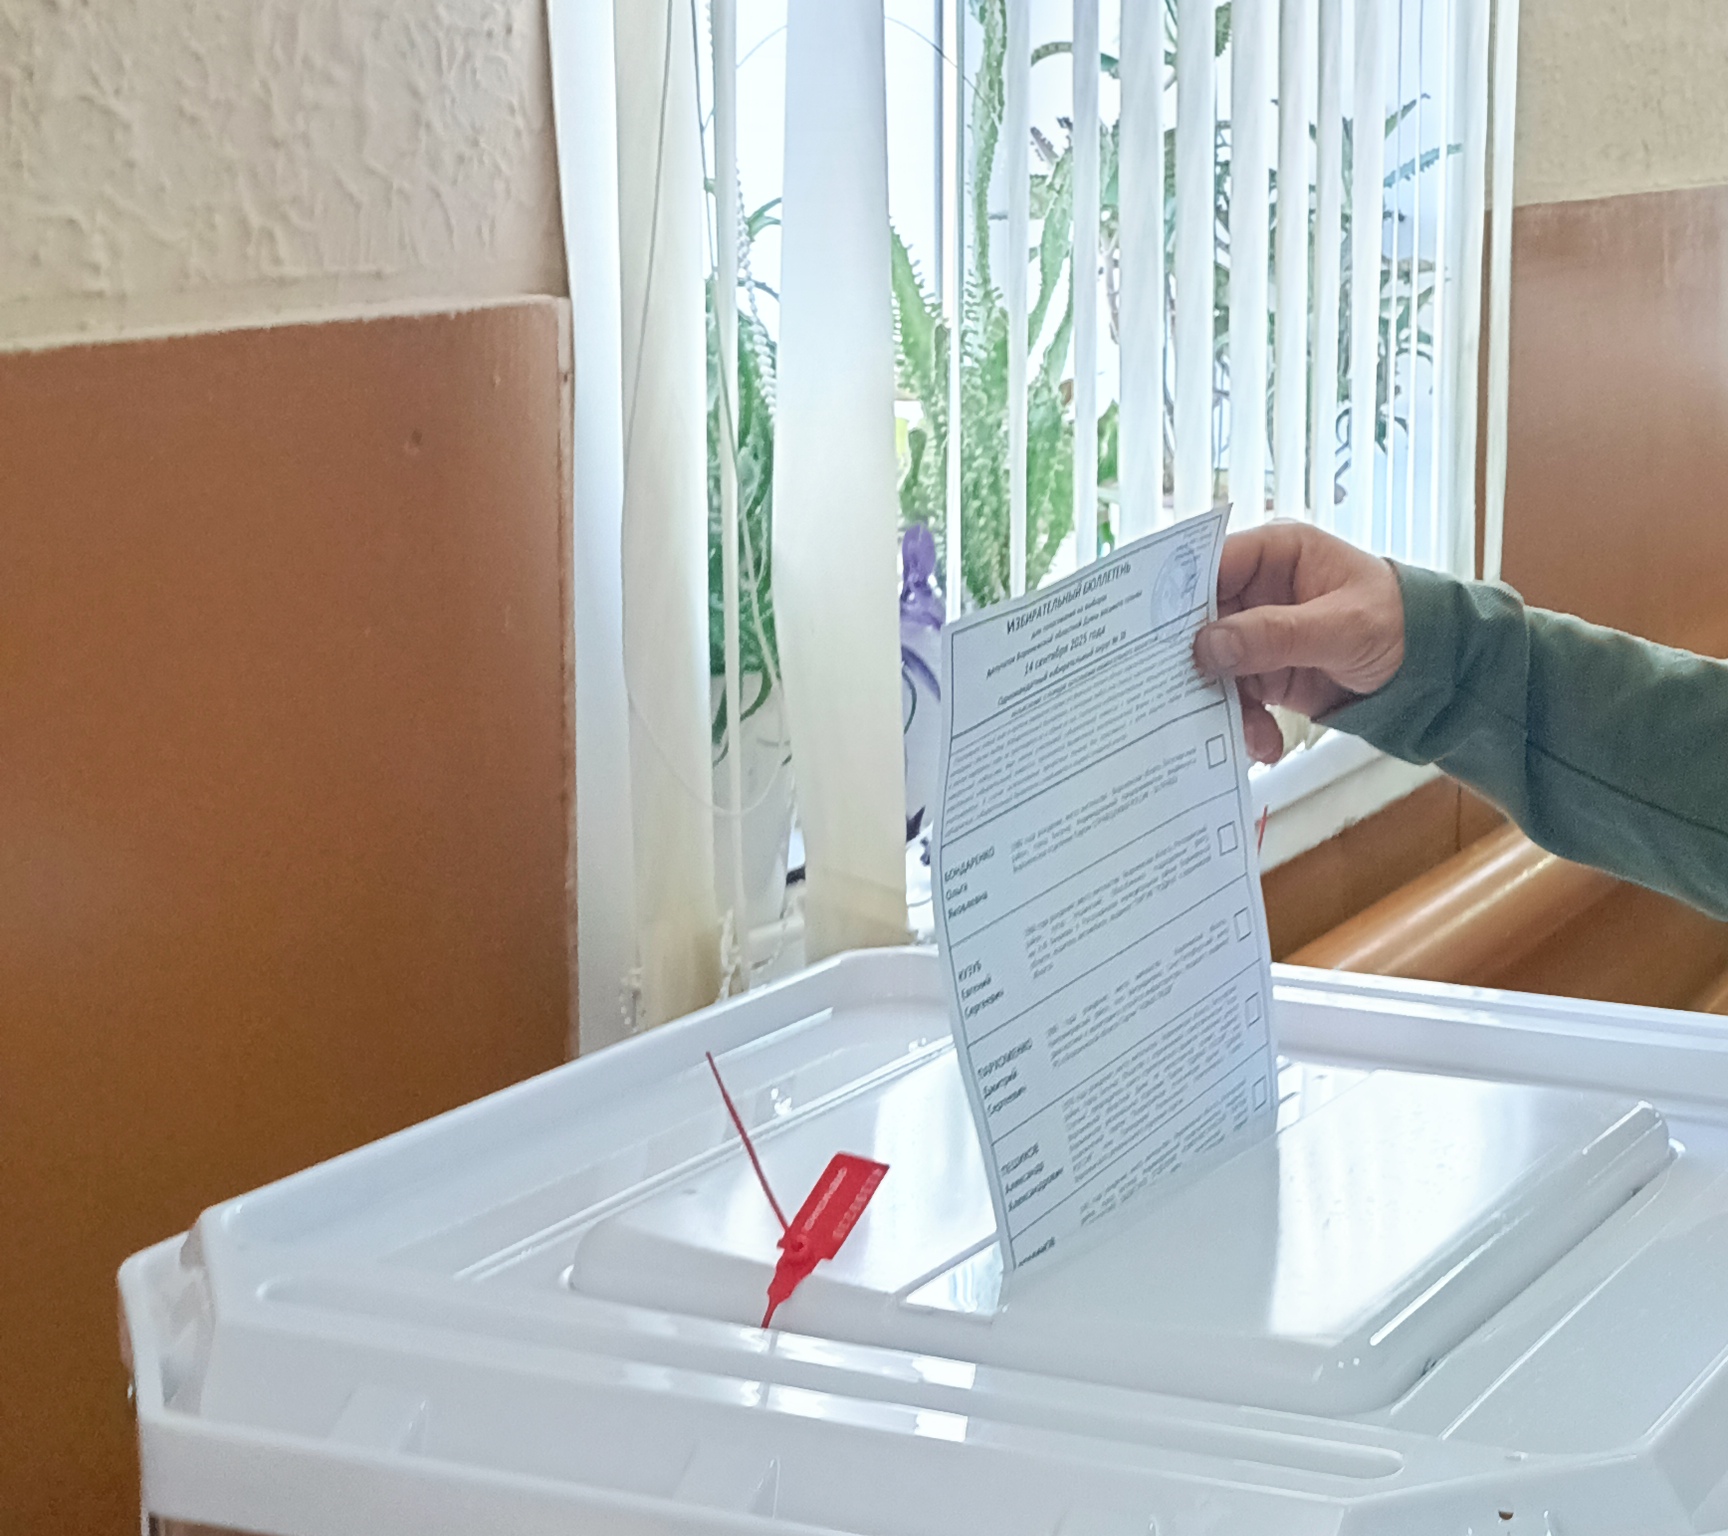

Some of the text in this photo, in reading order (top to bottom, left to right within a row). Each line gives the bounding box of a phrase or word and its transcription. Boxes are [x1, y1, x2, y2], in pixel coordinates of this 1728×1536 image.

[1006, 559, 1133, 635] ИЗБИРАТЕЛЬНЫЙ БЮЛЛЕТЕНЬ
[1034, 641, 1068, 670] сентября
[1069, 630, 1088, 652] 2025
